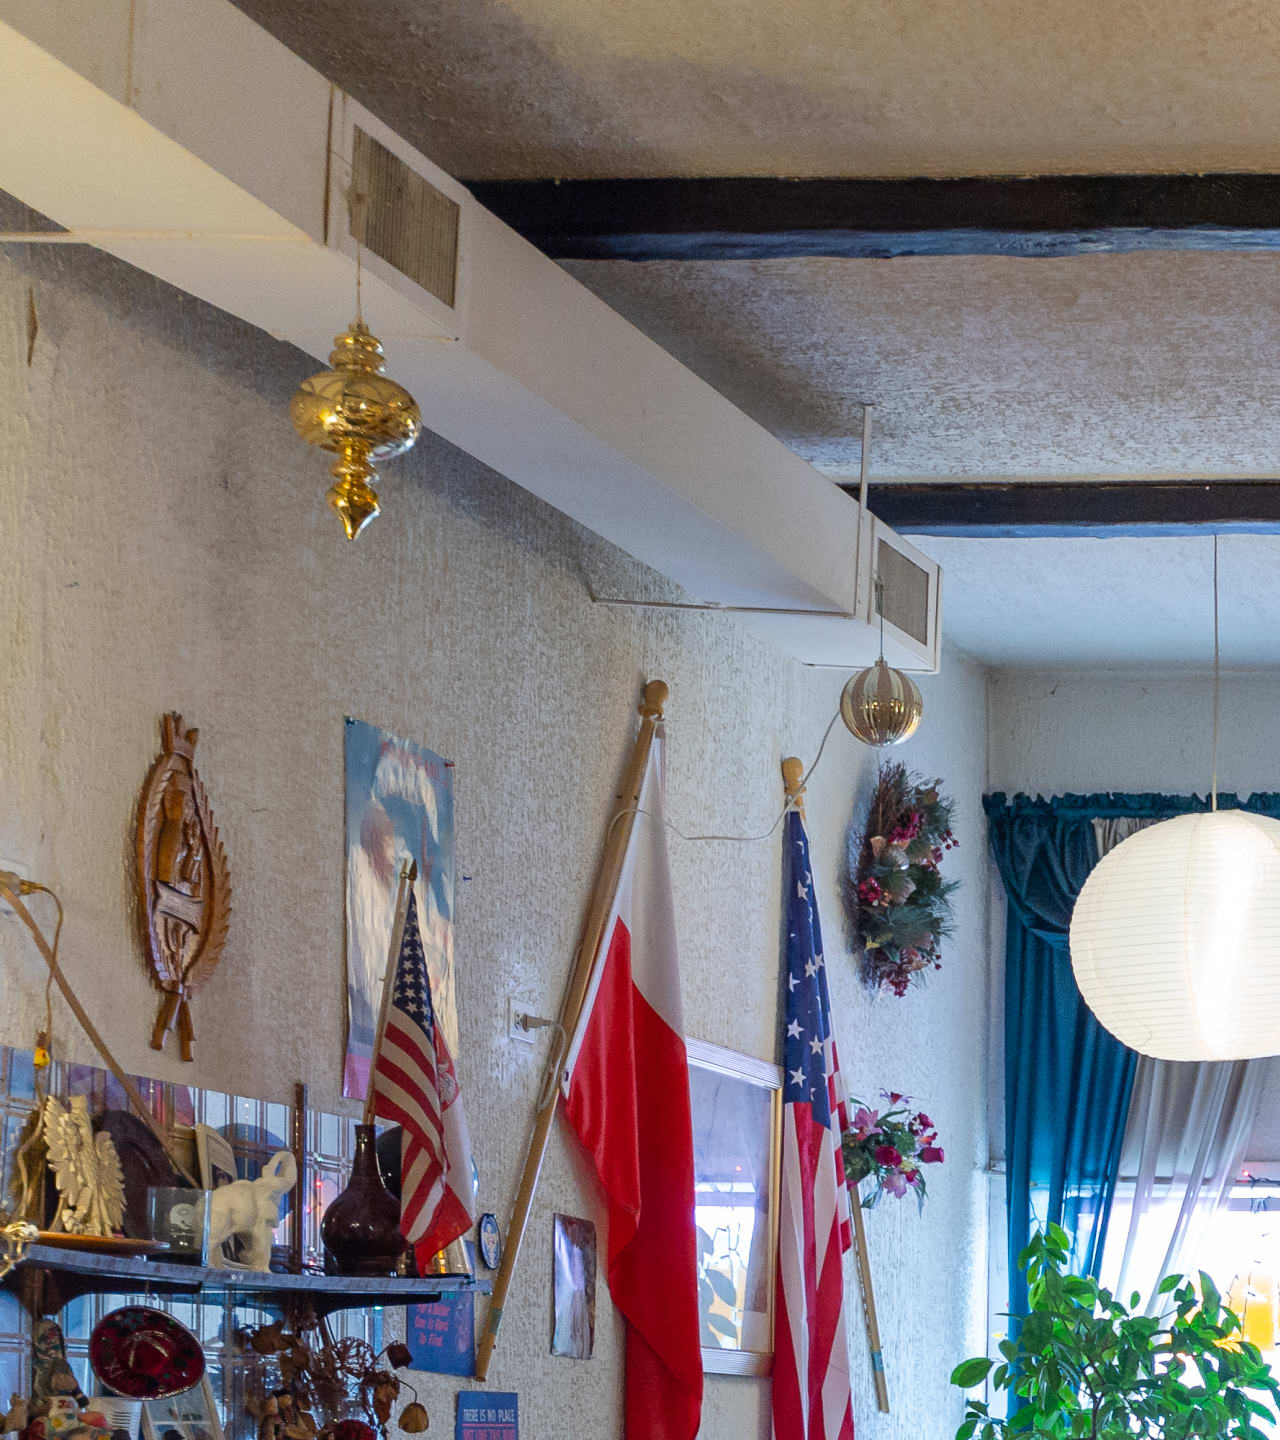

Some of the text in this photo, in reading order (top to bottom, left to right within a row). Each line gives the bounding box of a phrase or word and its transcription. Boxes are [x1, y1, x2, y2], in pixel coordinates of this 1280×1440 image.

[463, 1408, 515, 1422] THERE IS NO PLACE
